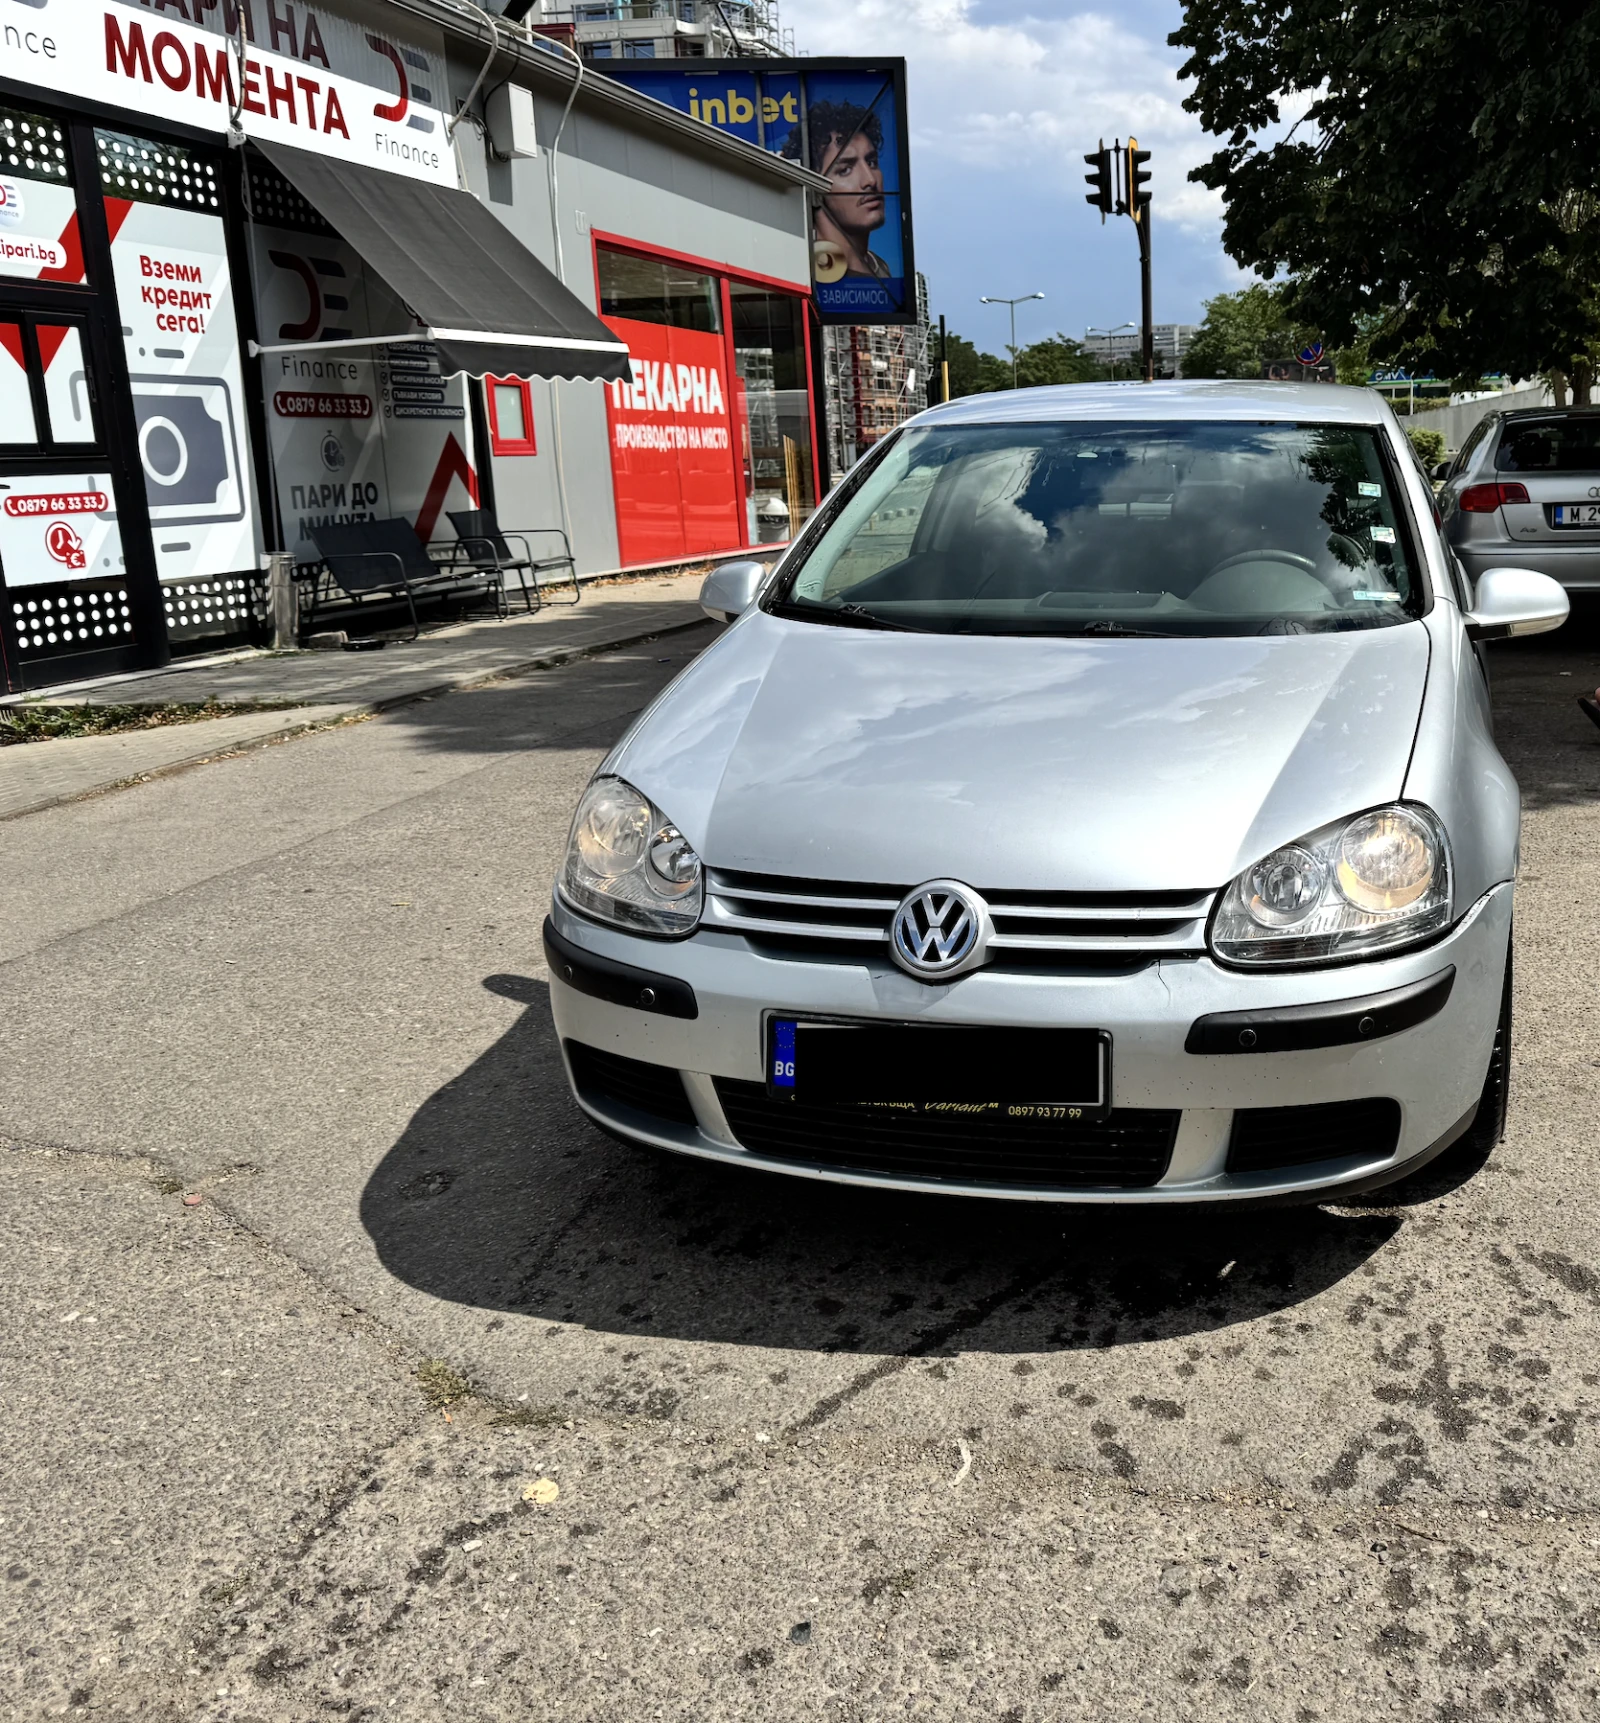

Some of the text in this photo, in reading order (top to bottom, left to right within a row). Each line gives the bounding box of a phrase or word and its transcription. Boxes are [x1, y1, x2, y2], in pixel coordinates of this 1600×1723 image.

[266, 0, 331, 69] НА
[104, 12, 350, 140] МОМЕНТА
[689, 88, 798, 124] inbet
[375, 133, 439, 168] Finance
[0, 239, 57, 264] ipari.bg
[139, 255, 202, 283] Вземи
[141, 285, 212, 310] кредит
[156, 313, 206, 334] сега!
[281, 354, 358, 380] Finance
[286, 397, 362, 414] 0879 66 33 33
[615, 423, 728, 452] ПРОИЗВОДСТВО НА МЯСТО
[17, 496, 97, 513] 0879 66 33 33
[290, 482, 378, 510] ПАРИ ДО
[774, 1061, 795, 1077] BG
[1008, 1106, 1082, 1118] 0897 93 77 99
